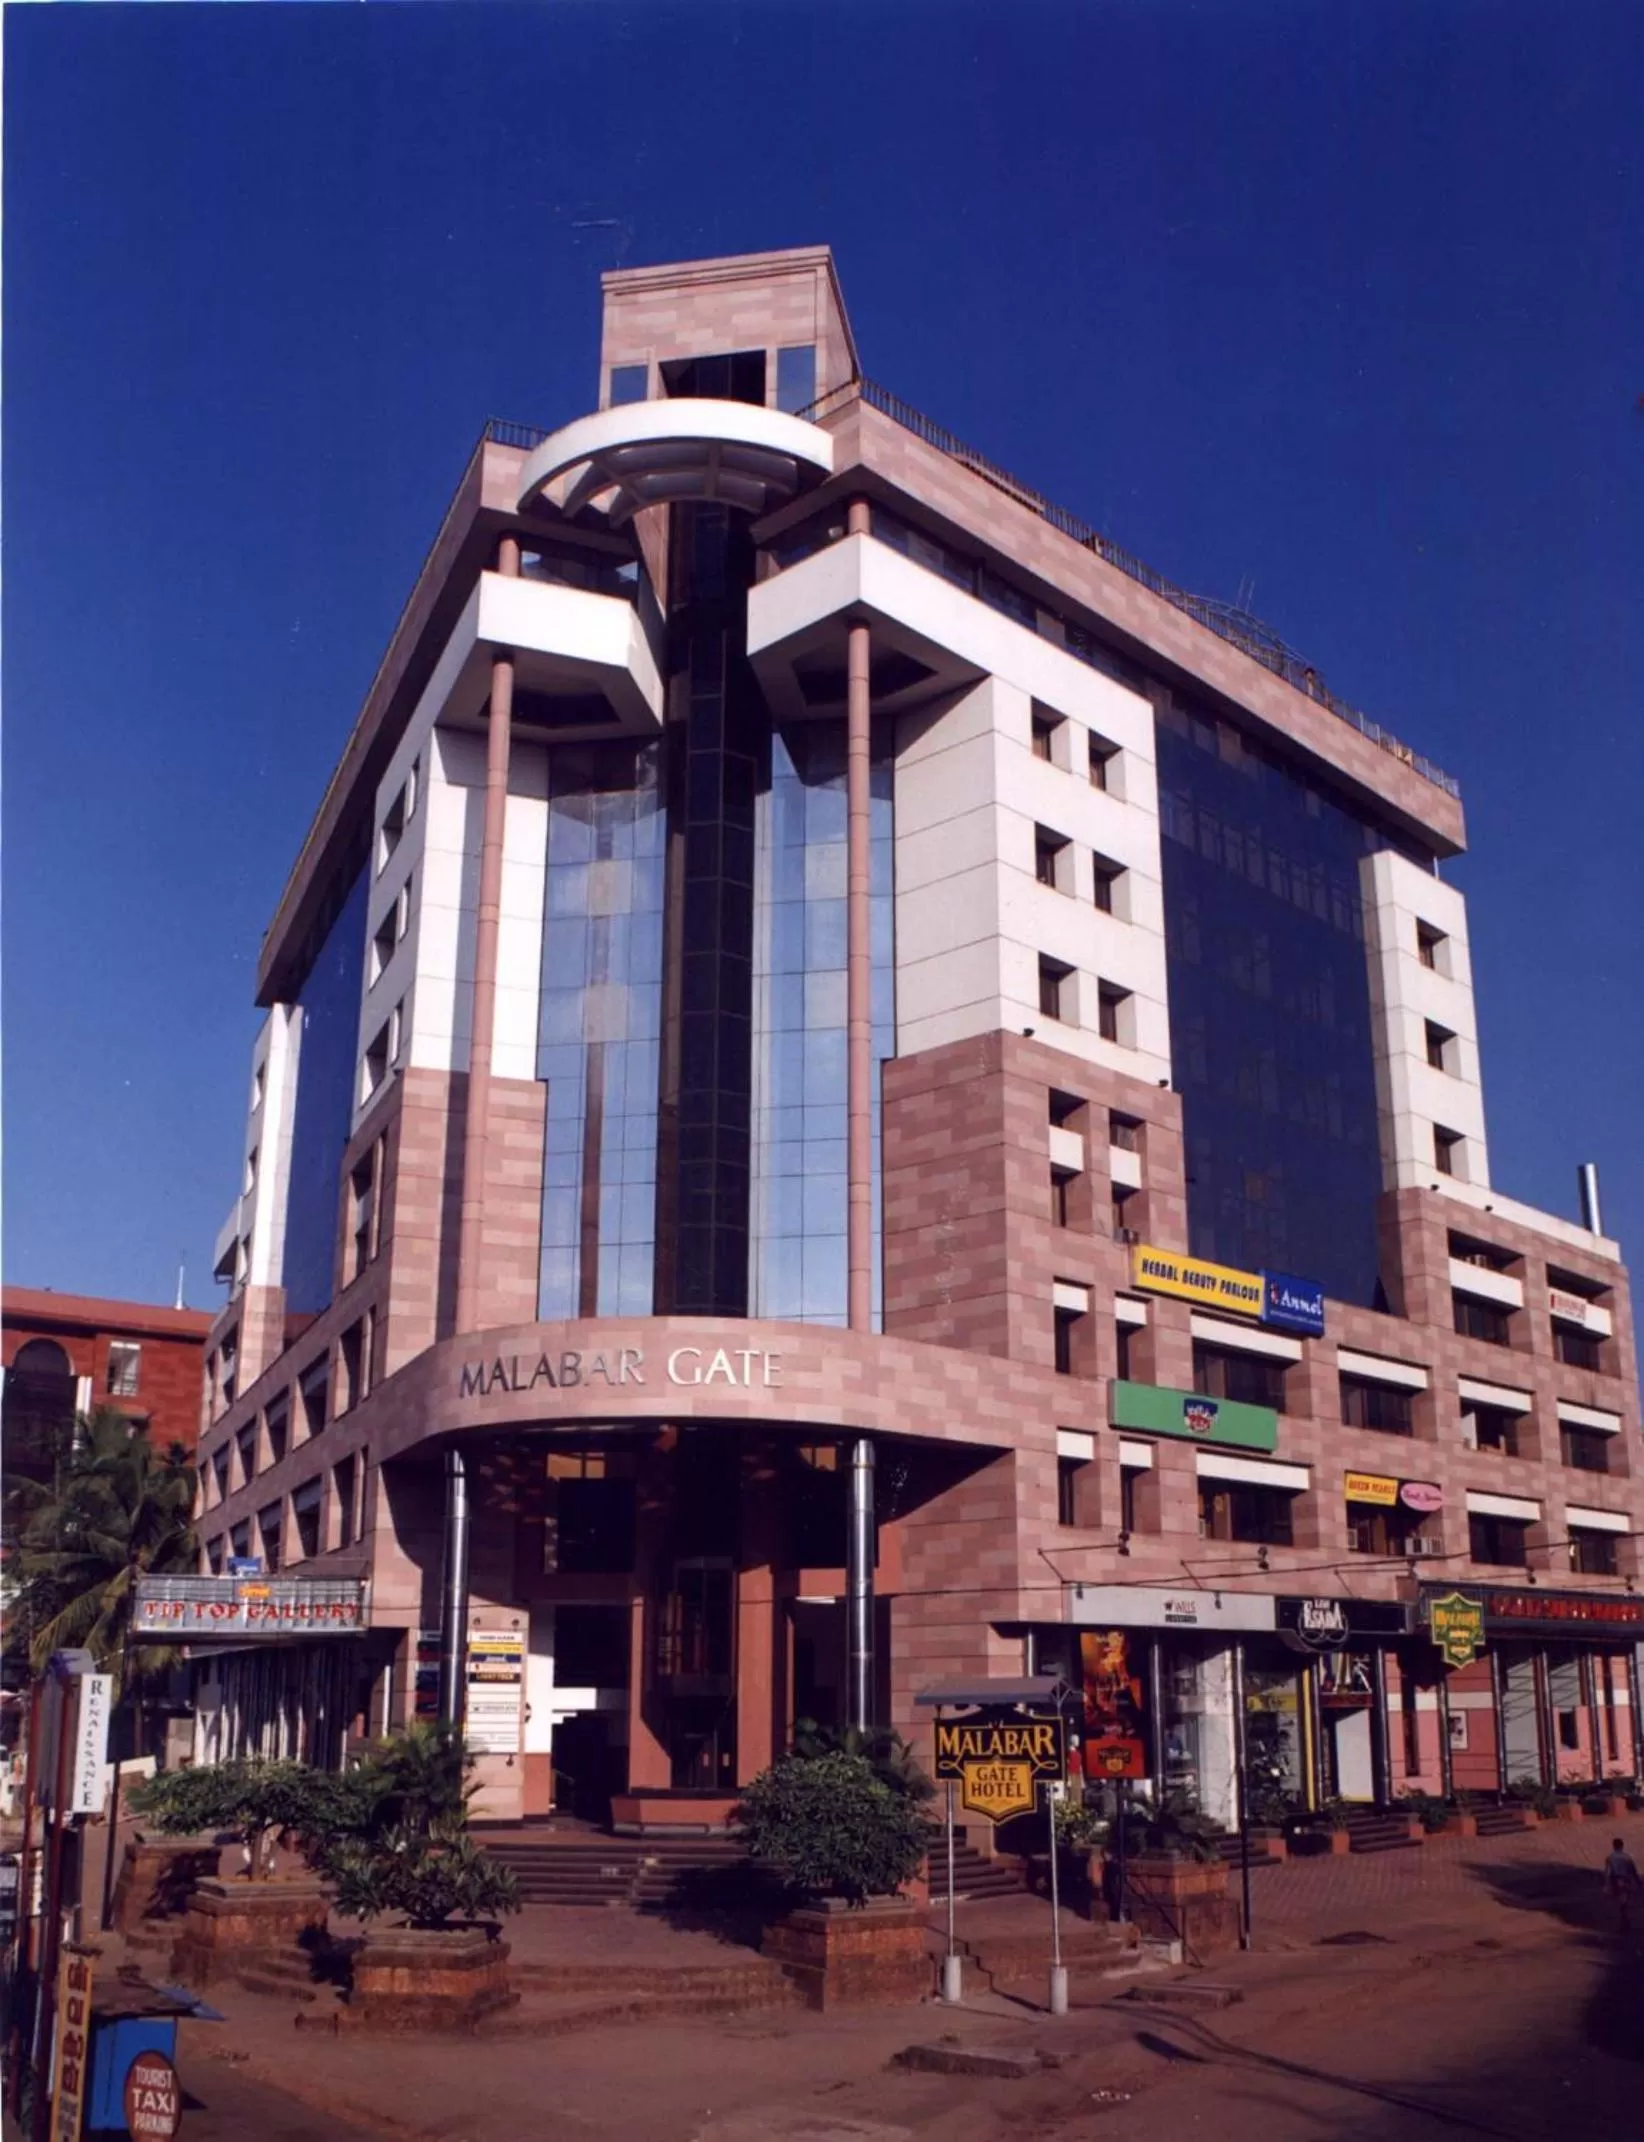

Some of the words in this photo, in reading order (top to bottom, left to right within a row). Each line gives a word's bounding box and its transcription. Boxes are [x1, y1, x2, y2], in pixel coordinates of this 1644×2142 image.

[1182, 1271, 1216, 1292] BEAUTY
[459, 1349, 645, 1398] MALABAR
[666, 1347, 785, 1388] GATE
[144, 1602, 185, 1618] TIP
[194, 1603, 240, 1618] TOP
[248, 1603, 359, 1619] GALLERY
[939, 1725, 1056, 1757] MALABAR
[976, 1766, 1018, 1782] GATE
[971, 1783, 1025, 1798] HOTEL
[135, 2065, 173, 2089] TOURIST
[132, 2089, 176, 2113] TAXI
[134, 2112, 174, 2134] PARKING
